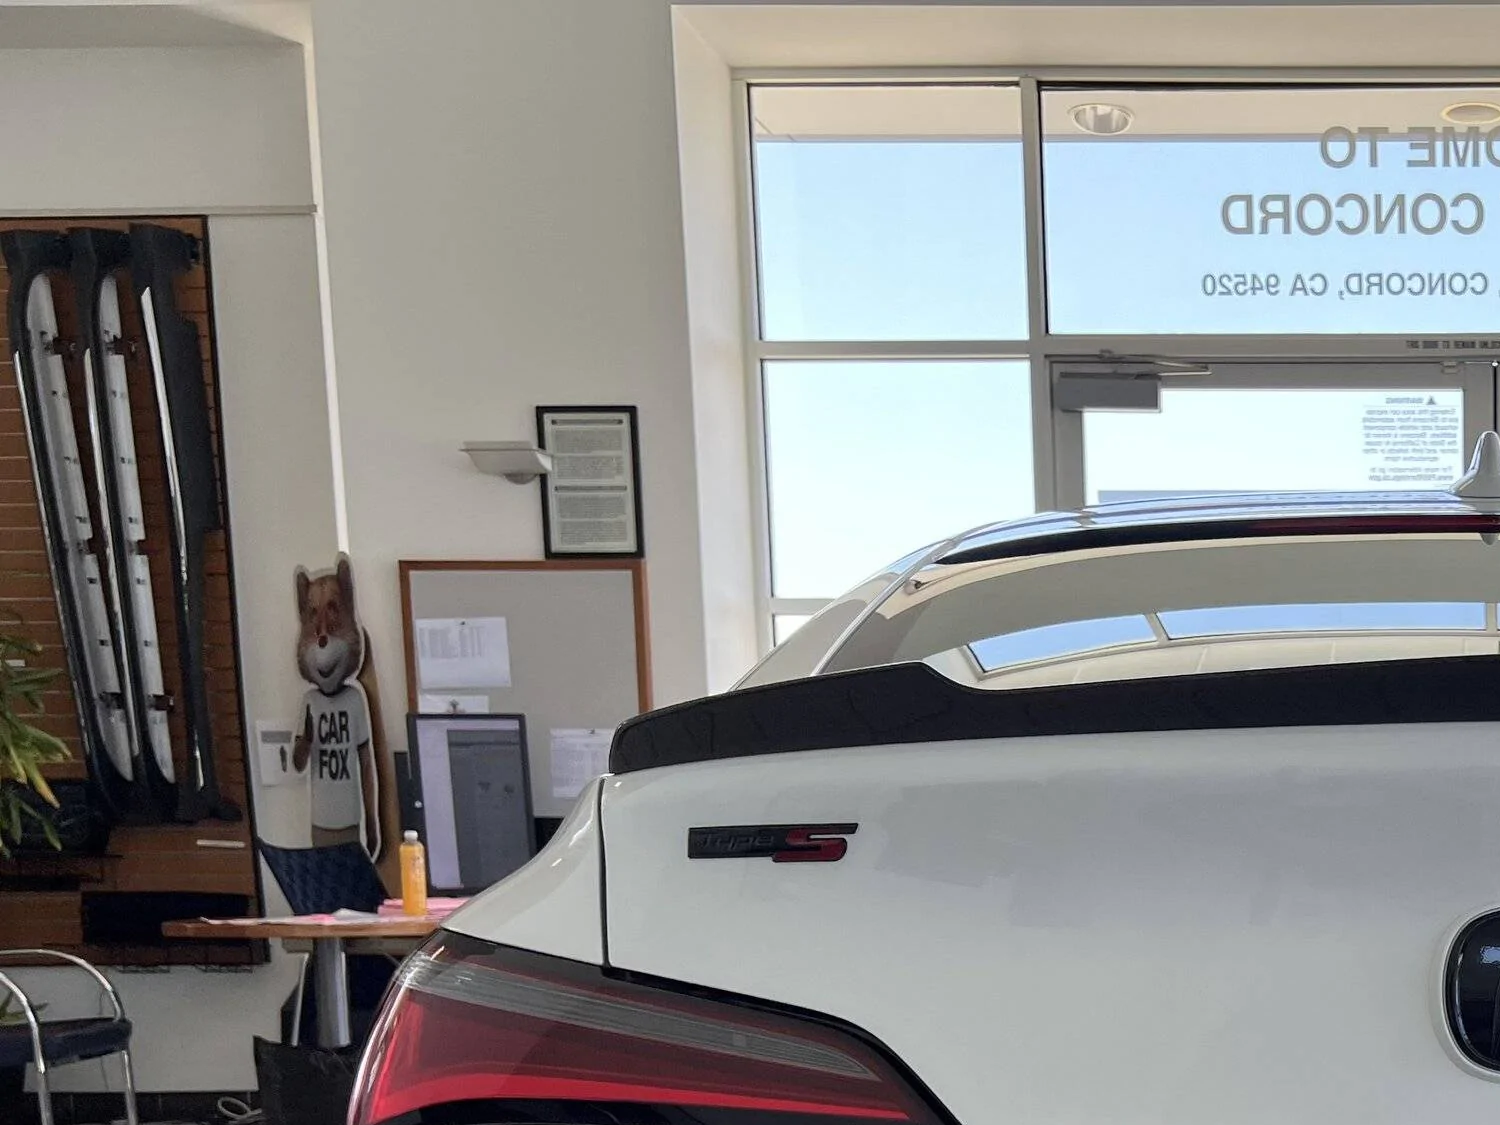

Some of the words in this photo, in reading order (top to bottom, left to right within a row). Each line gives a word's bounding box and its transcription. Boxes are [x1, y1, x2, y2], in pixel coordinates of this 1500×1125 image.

[318, 710, 350, 745] CAR
[319, 748, 350, 780] FOX
[772, 822, 858, 863] S
